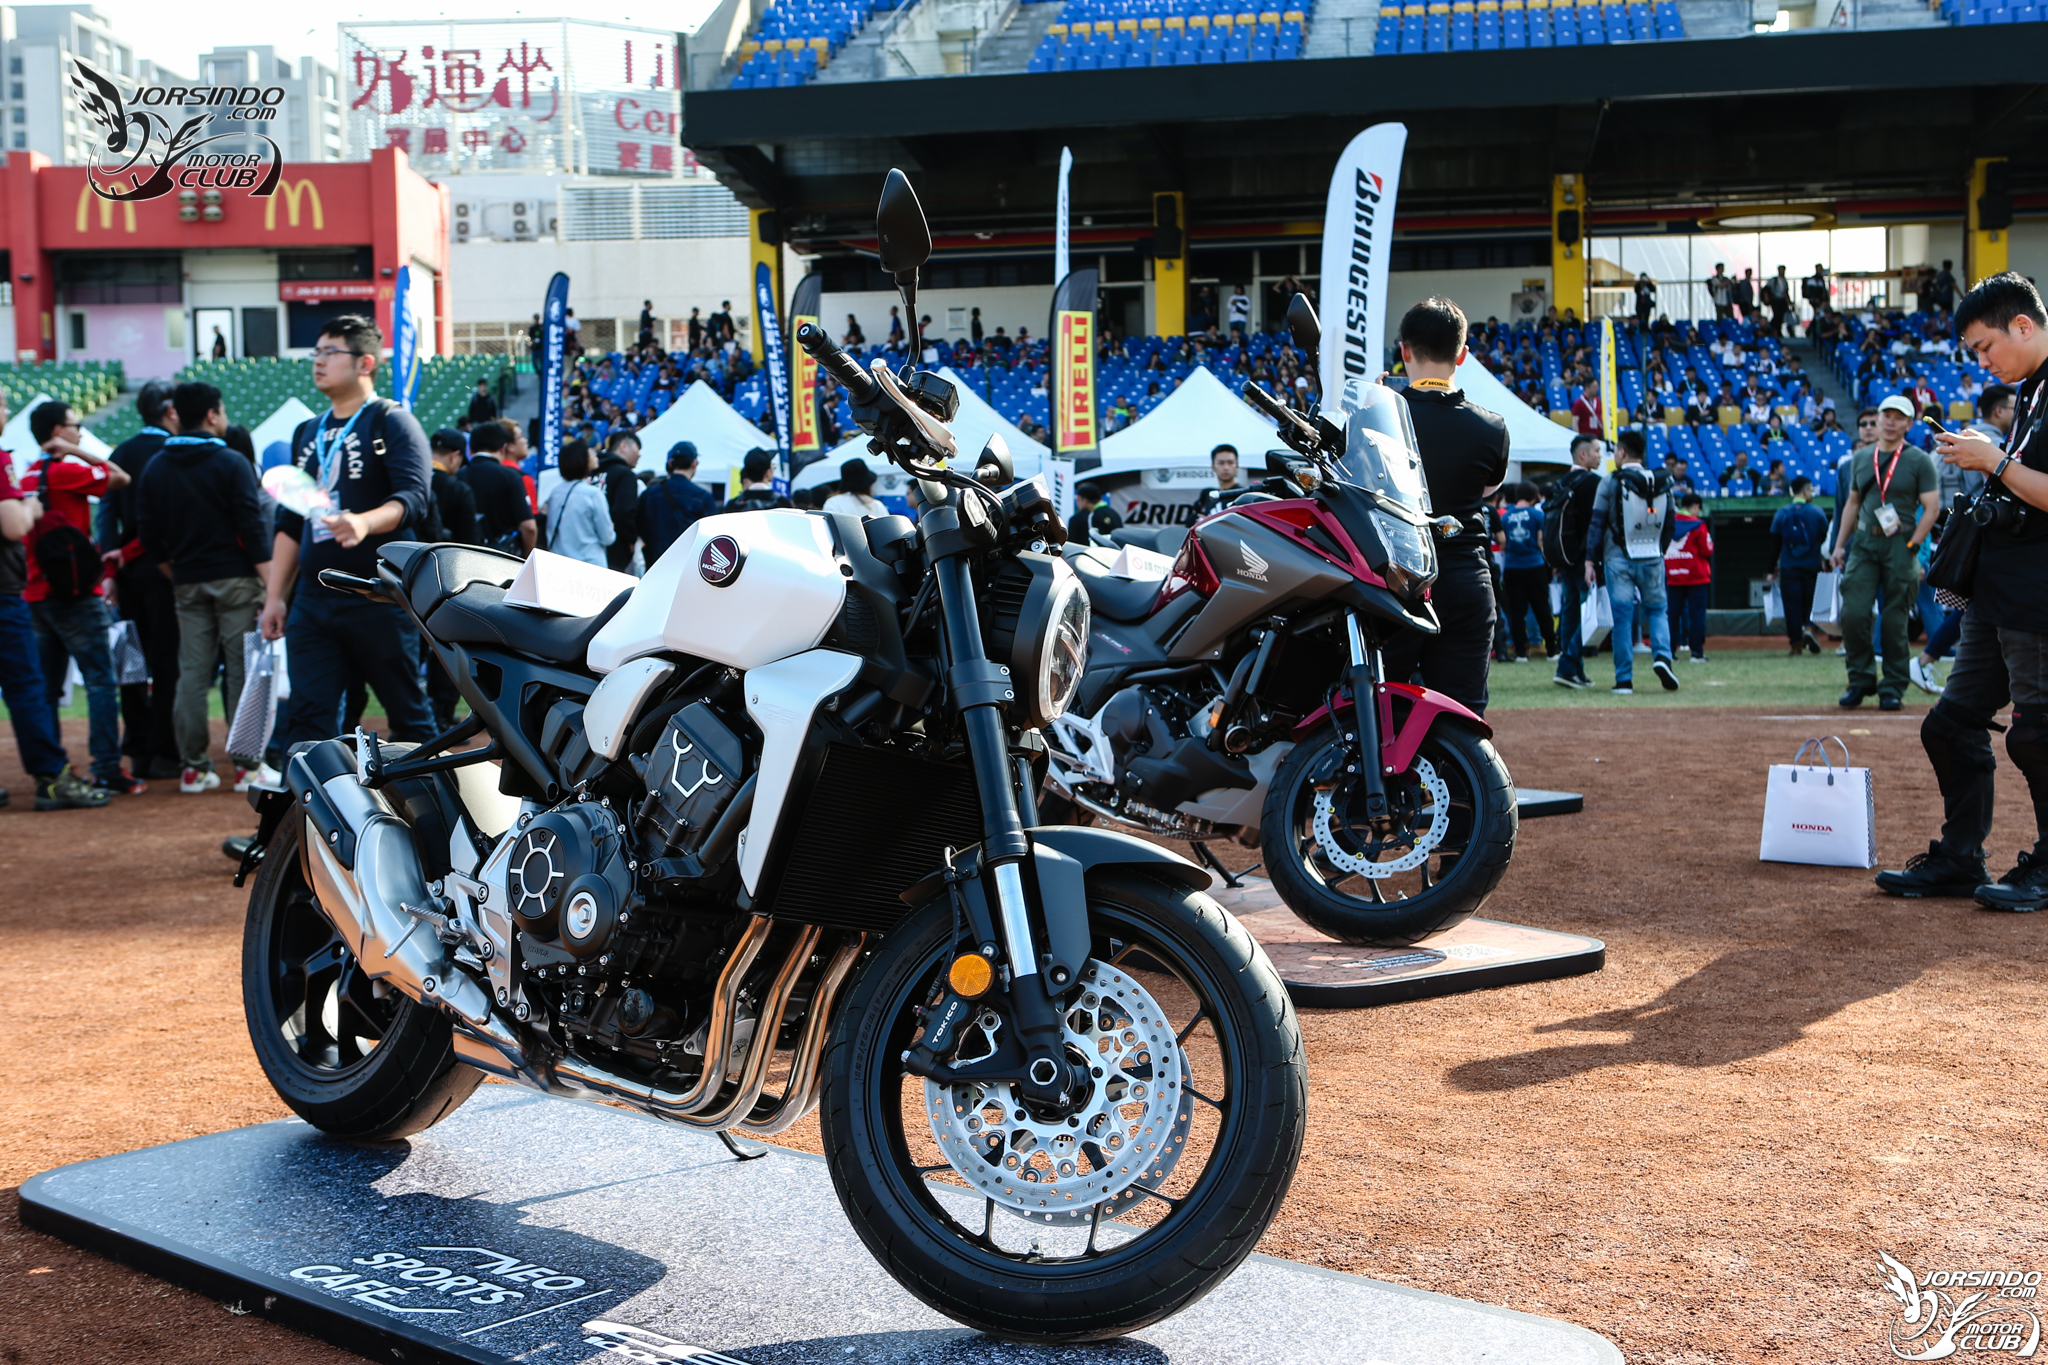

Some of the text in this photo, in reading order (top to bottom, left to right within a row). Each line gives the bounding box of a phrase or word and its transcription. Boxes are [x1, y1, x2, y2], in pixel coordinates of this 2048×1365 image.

[544, 324, 559, 466] METZELER
[762, 310, 789, 449] METZELER
[1061, 314, 1091, 446] PIRELLI
[343, 431, 364, 480] BEACH
[1176, 470, 1215, 478] BRIDGES
[1125, 501, 1193, 525] BRID
[702, 563, 726, 575] HONDA
[1236, 568, 1268, 582] HONDA
[1792, 823, 1833, 832] HONDA
[932, 1001, 958, 1043] TOKICO
[353, 1252, 524, 1306] SPORTS
[479, 1255, 586, 1292] NEO
